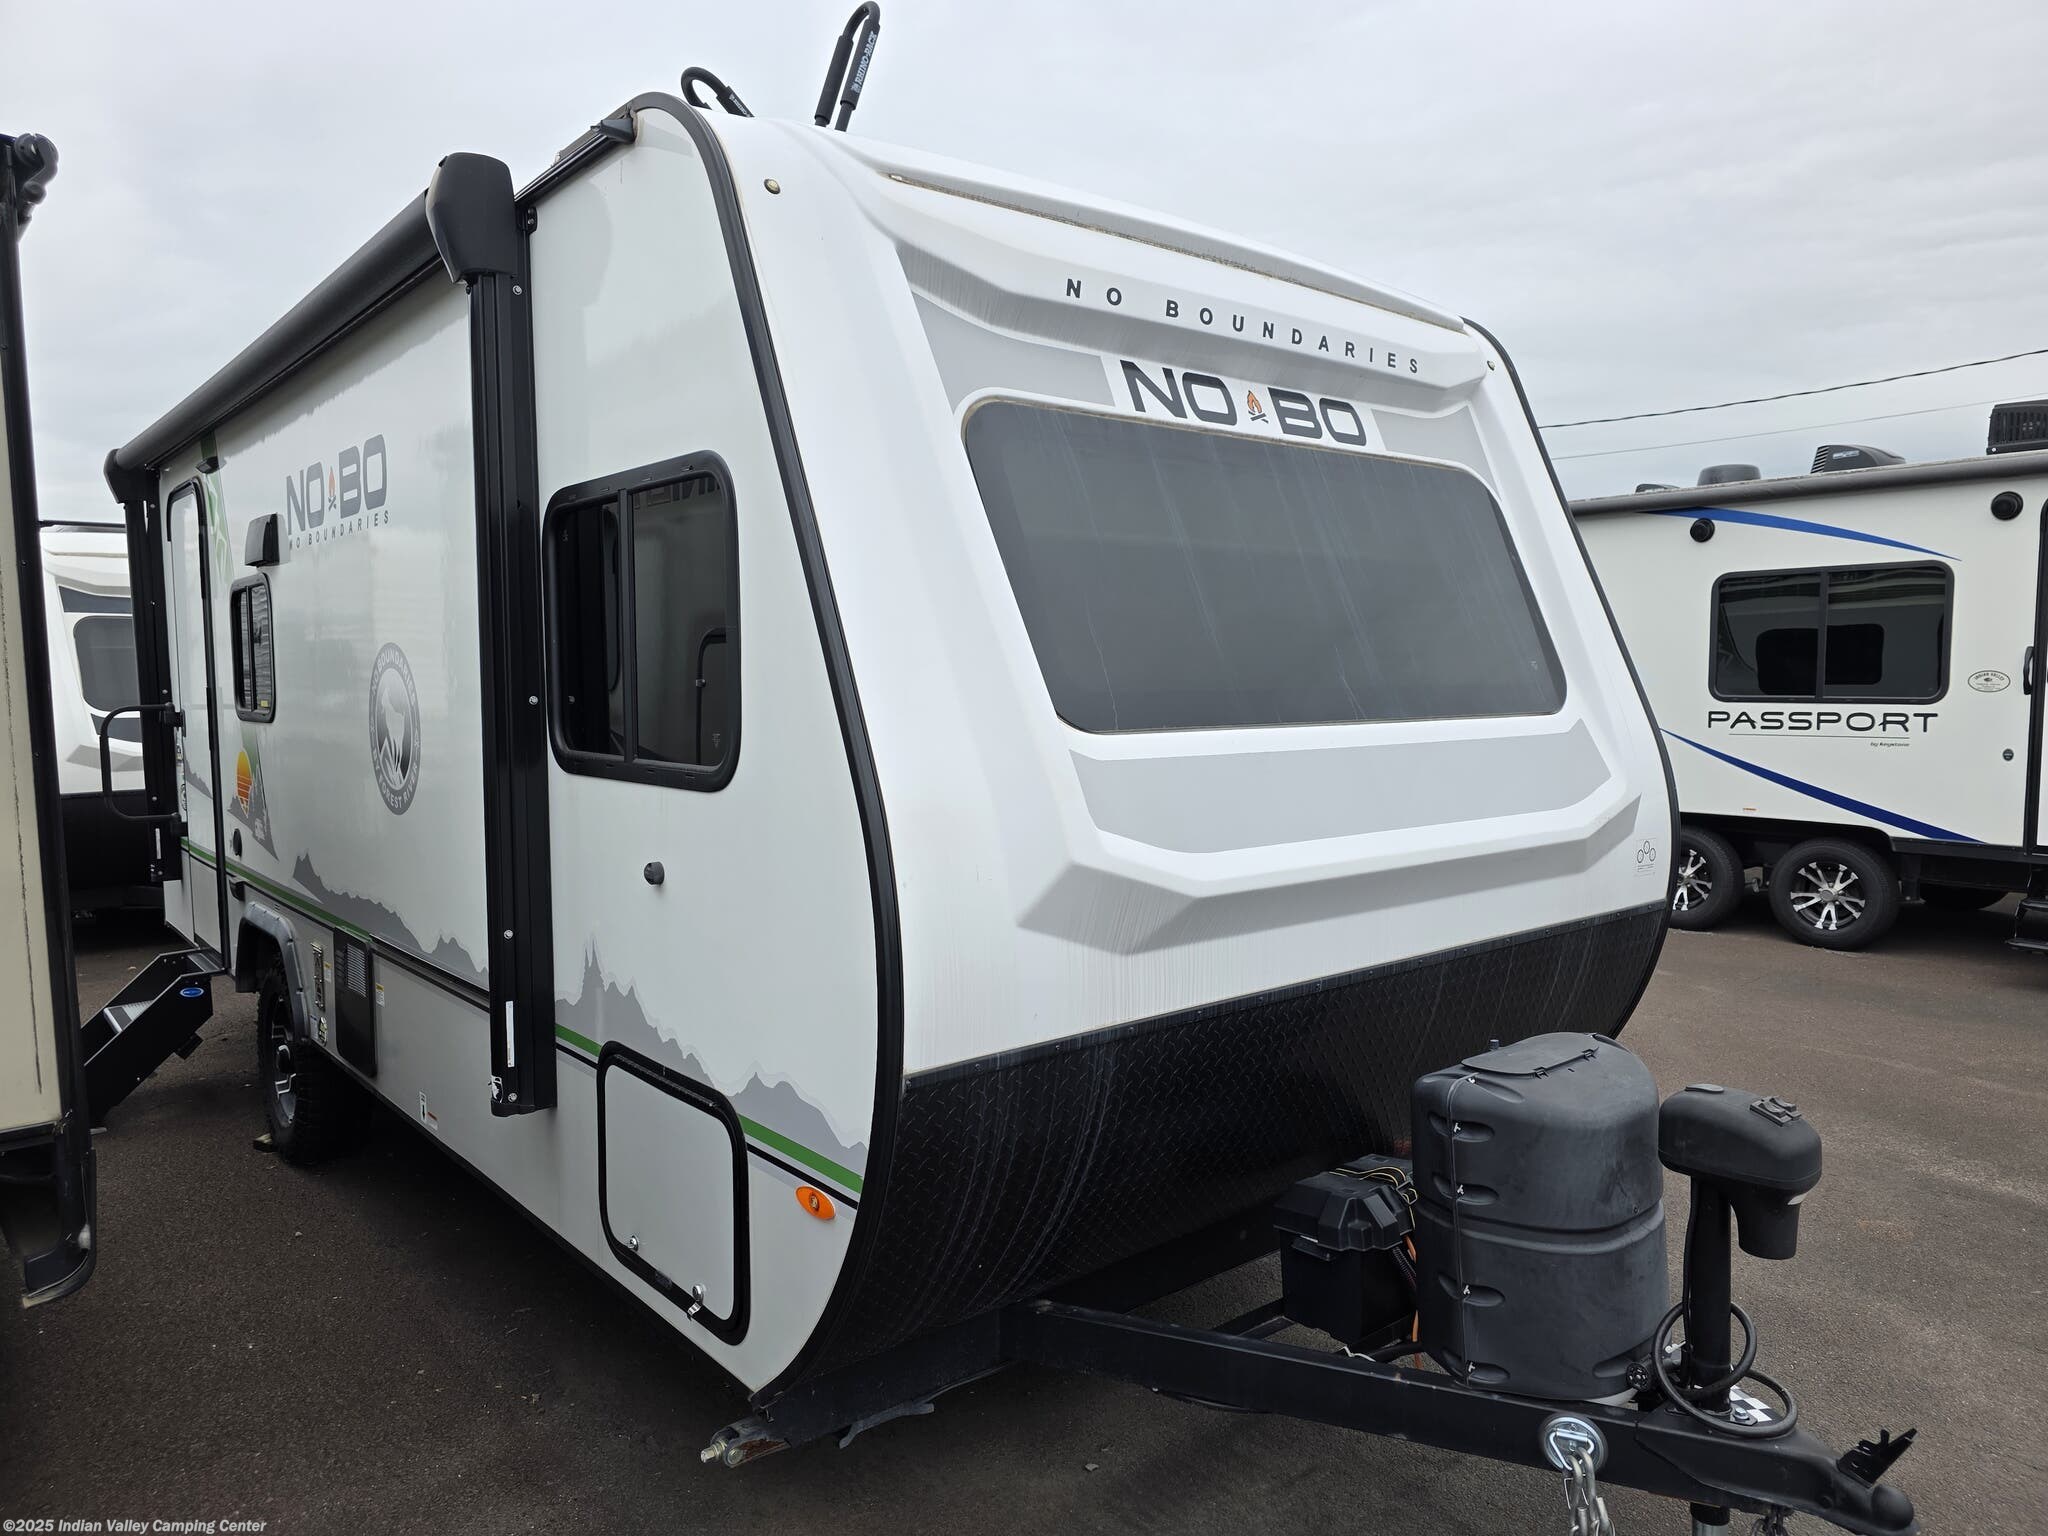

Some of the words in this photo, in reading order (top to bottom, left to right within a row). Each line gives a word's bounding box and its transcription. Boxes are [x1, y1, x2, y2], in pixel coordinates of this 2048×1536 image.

[854, 30, 878, 85] RHINO-RACK
[1065, 277, 1123, 307] NO
[1165, 299, 1419, 374] BOUNDARIES
[1119, 359, 1238, 427] NO
[1267, 386, 1368, 447] BO
[286, 461, 325, 536] NO
[338, 433, 388, 519] BO
[308, 510, 389, 546] BOUNDARIES
[376, 648, 417, 708] BOUNDARIES
[1708, 711, 1939, 733] PASSPORT
[378, 773, 402, 810] FOREST
